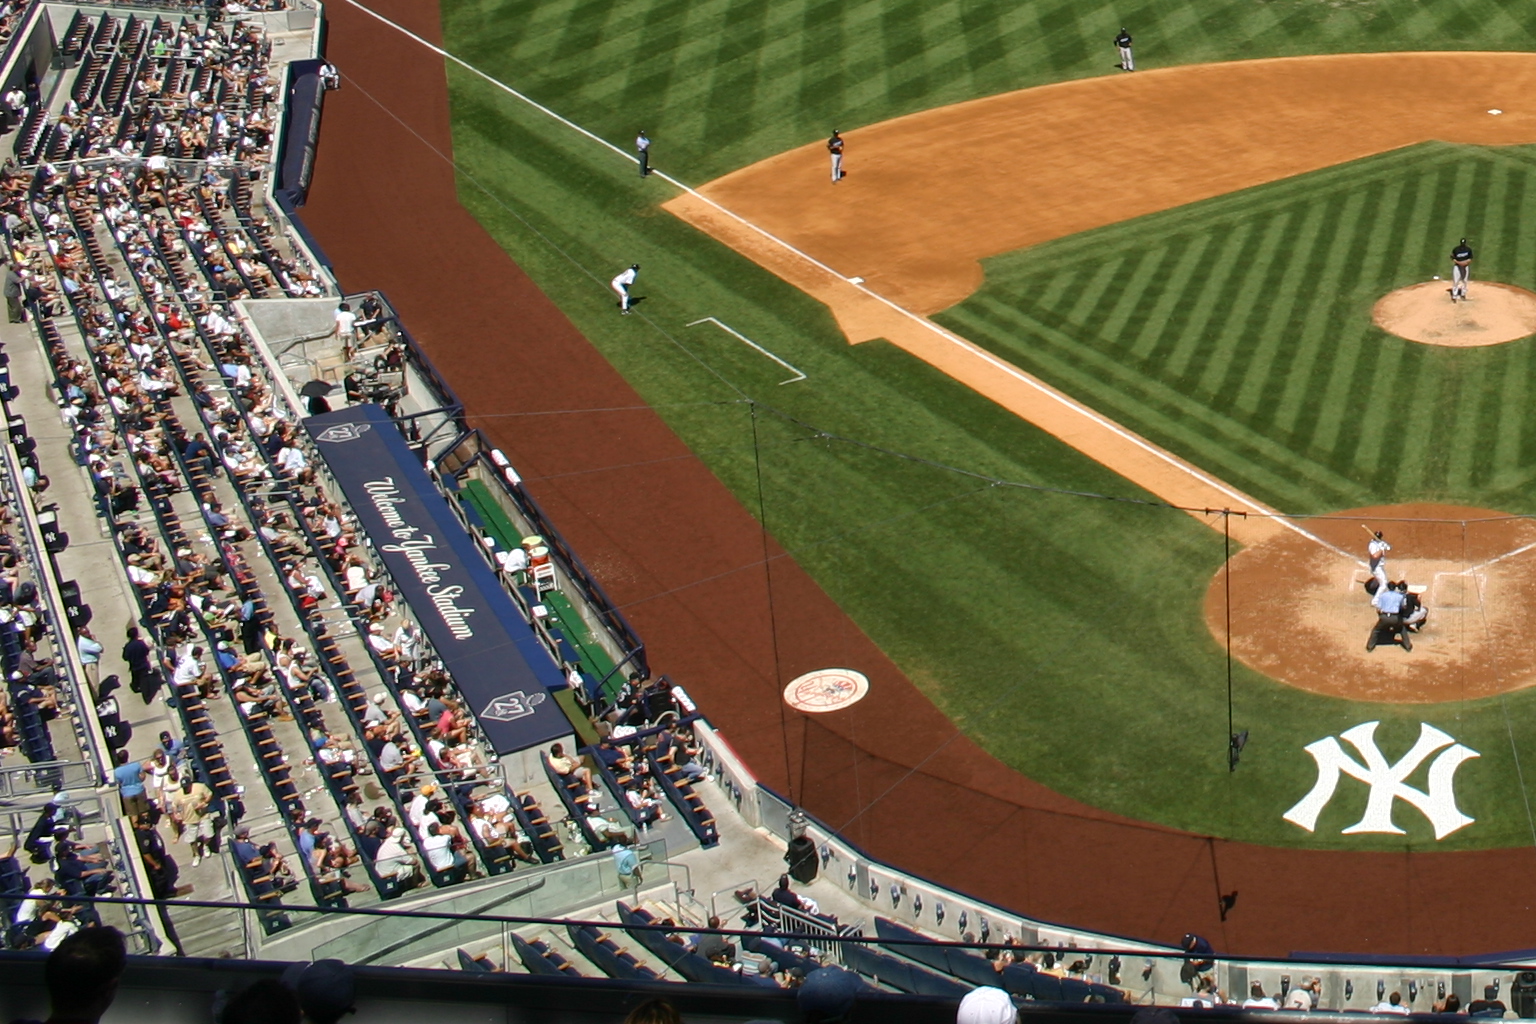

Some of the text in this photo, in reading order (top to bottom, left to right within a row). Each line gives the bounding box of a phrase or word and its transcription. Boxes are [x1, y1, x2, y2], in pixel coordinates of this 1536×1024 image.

[363, 476, 475, 640] Welcome to Yankee Stadium
[1282, 719, 1482, 841] NY
